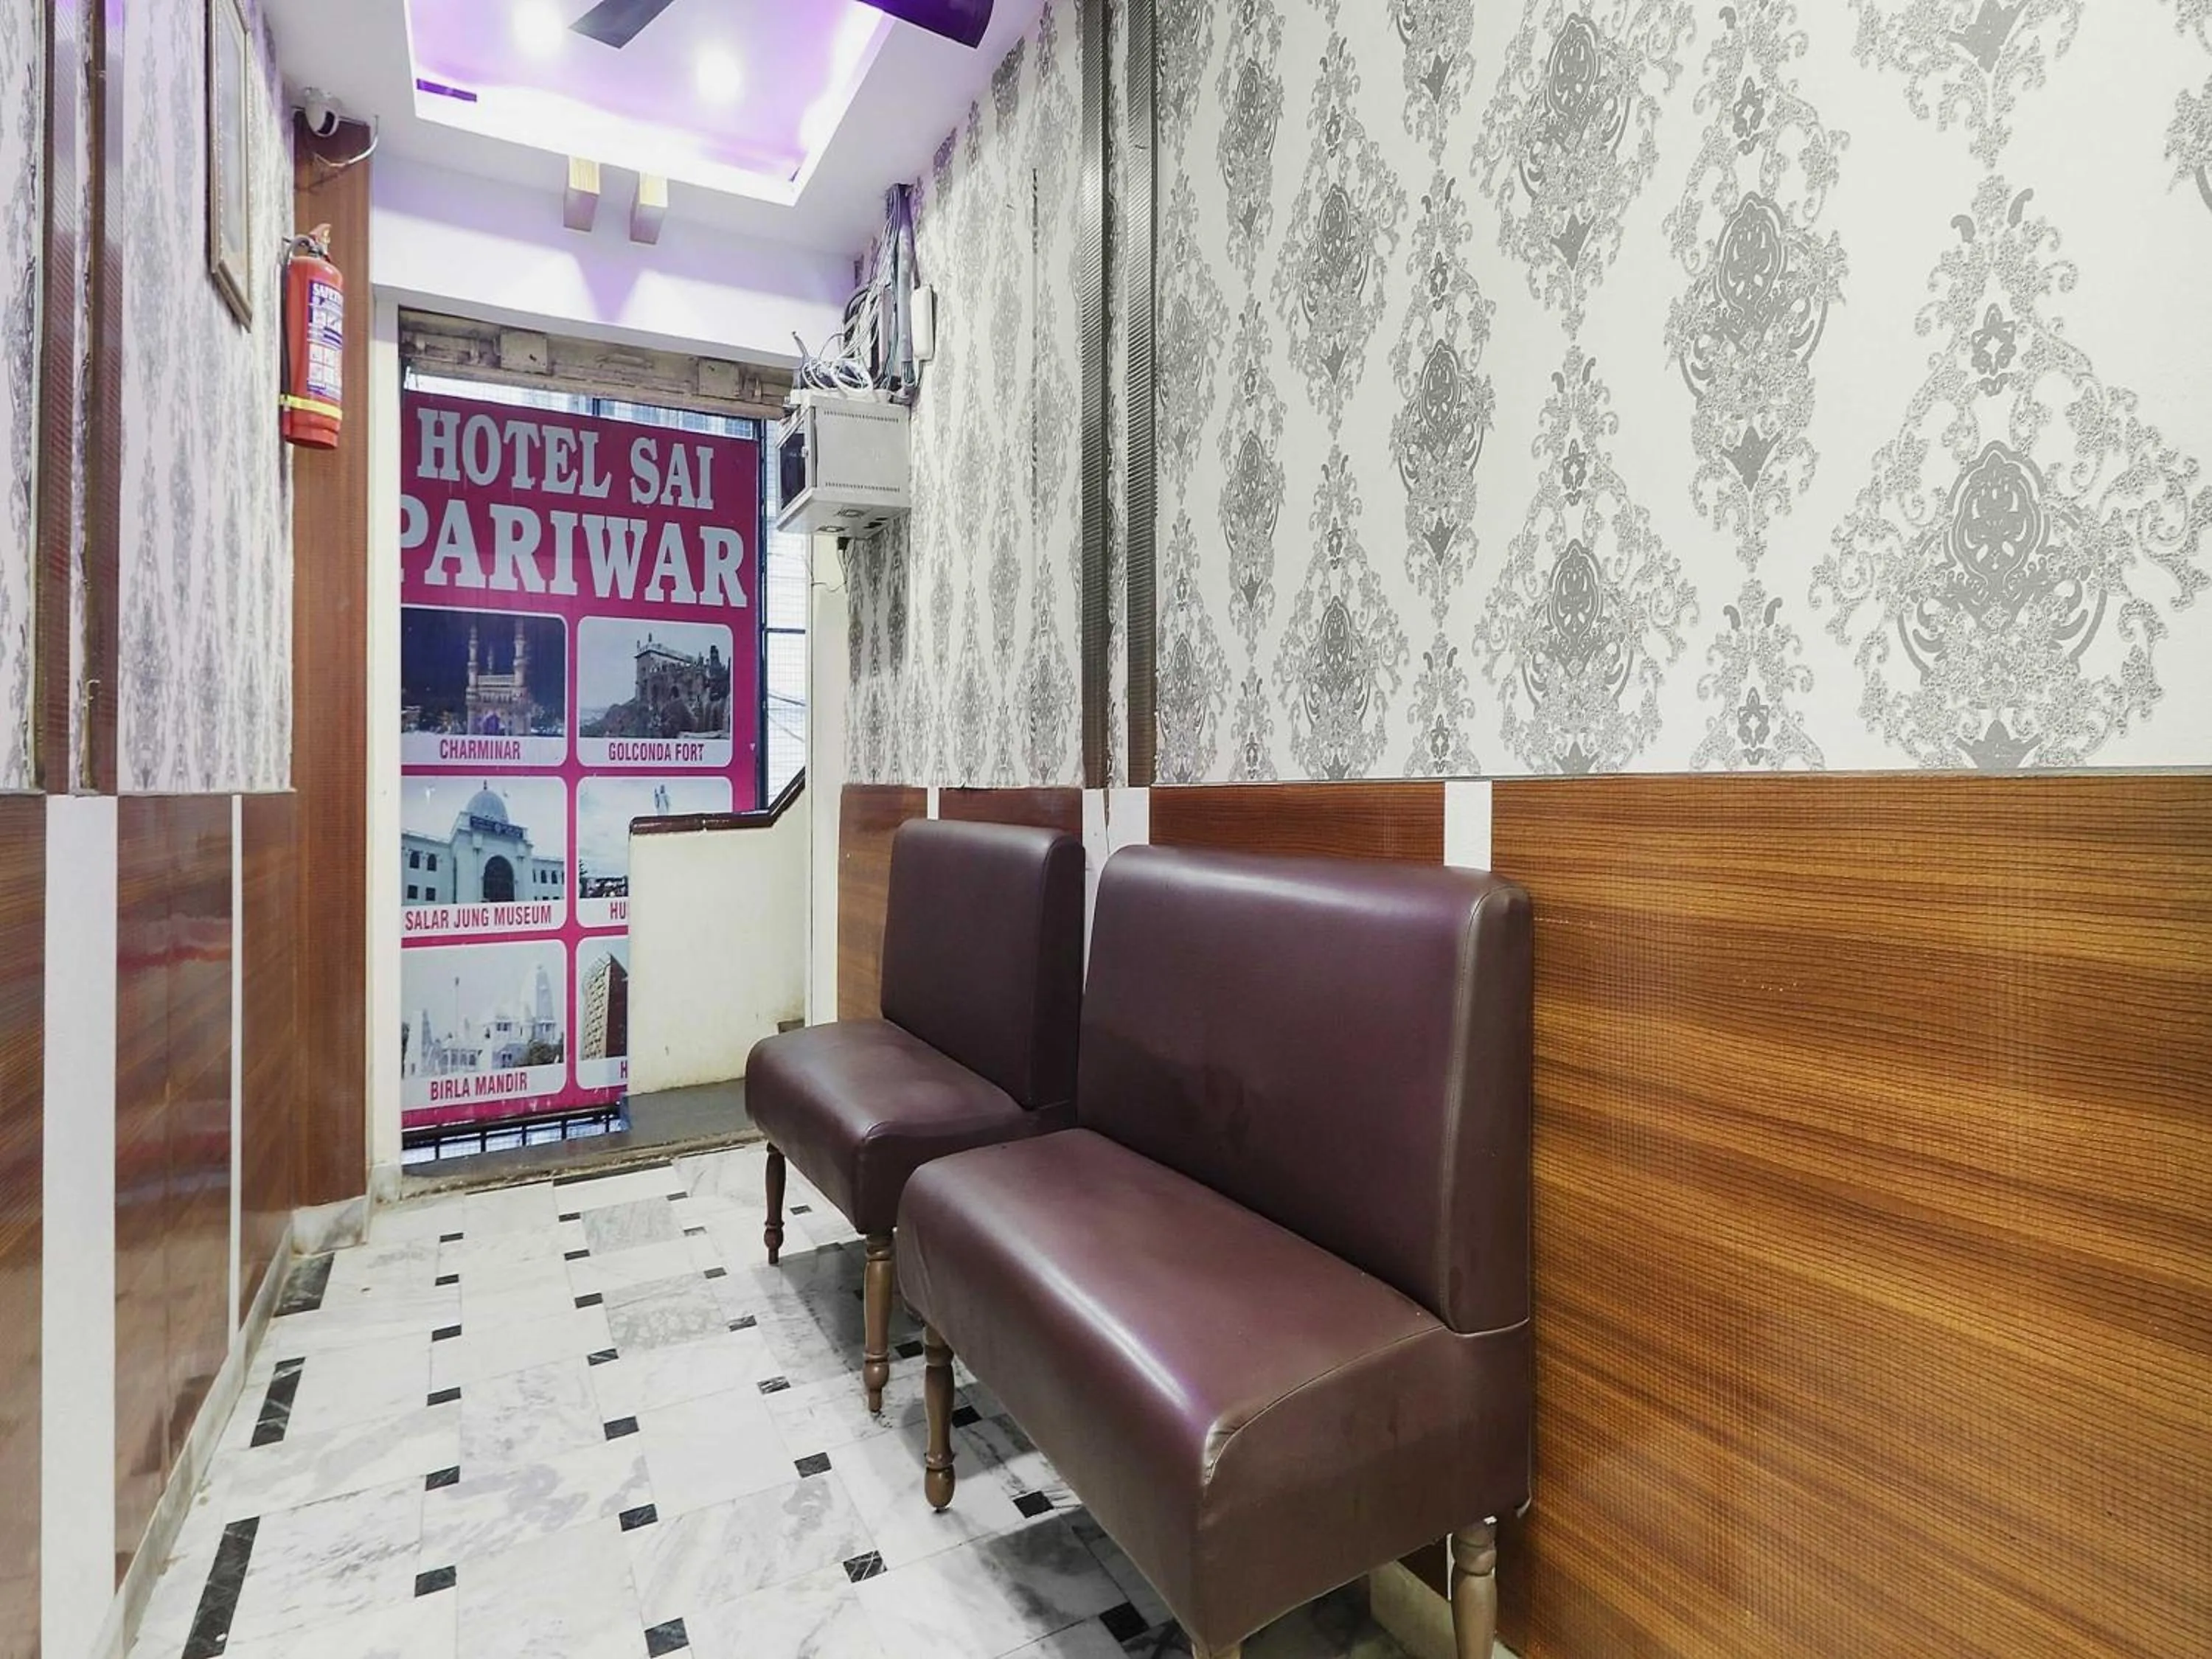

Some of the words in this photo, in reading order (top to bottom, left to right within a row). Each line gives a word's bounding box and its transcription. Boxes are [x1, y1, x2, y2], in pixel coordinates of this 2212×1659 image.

[417, 408, 612, 498] HOTEL
[630, 438, 714, 509] SAI
[400, 494, 748, 608] PARIWAR
[439, 739, 521, 760] CHARMINAR
[608, 742, 672, 762] GOLCONDA
[675, 743, 705, 762] FORT
[405, 909, 449, 931] SALAR
[453, 906, 490, 928] JUNG
[494, 905, 552, 926] MUSEUM
[430, 1075, 470, 1101] BIRLA
[476, 1072, 528, 1096] MANDIR
